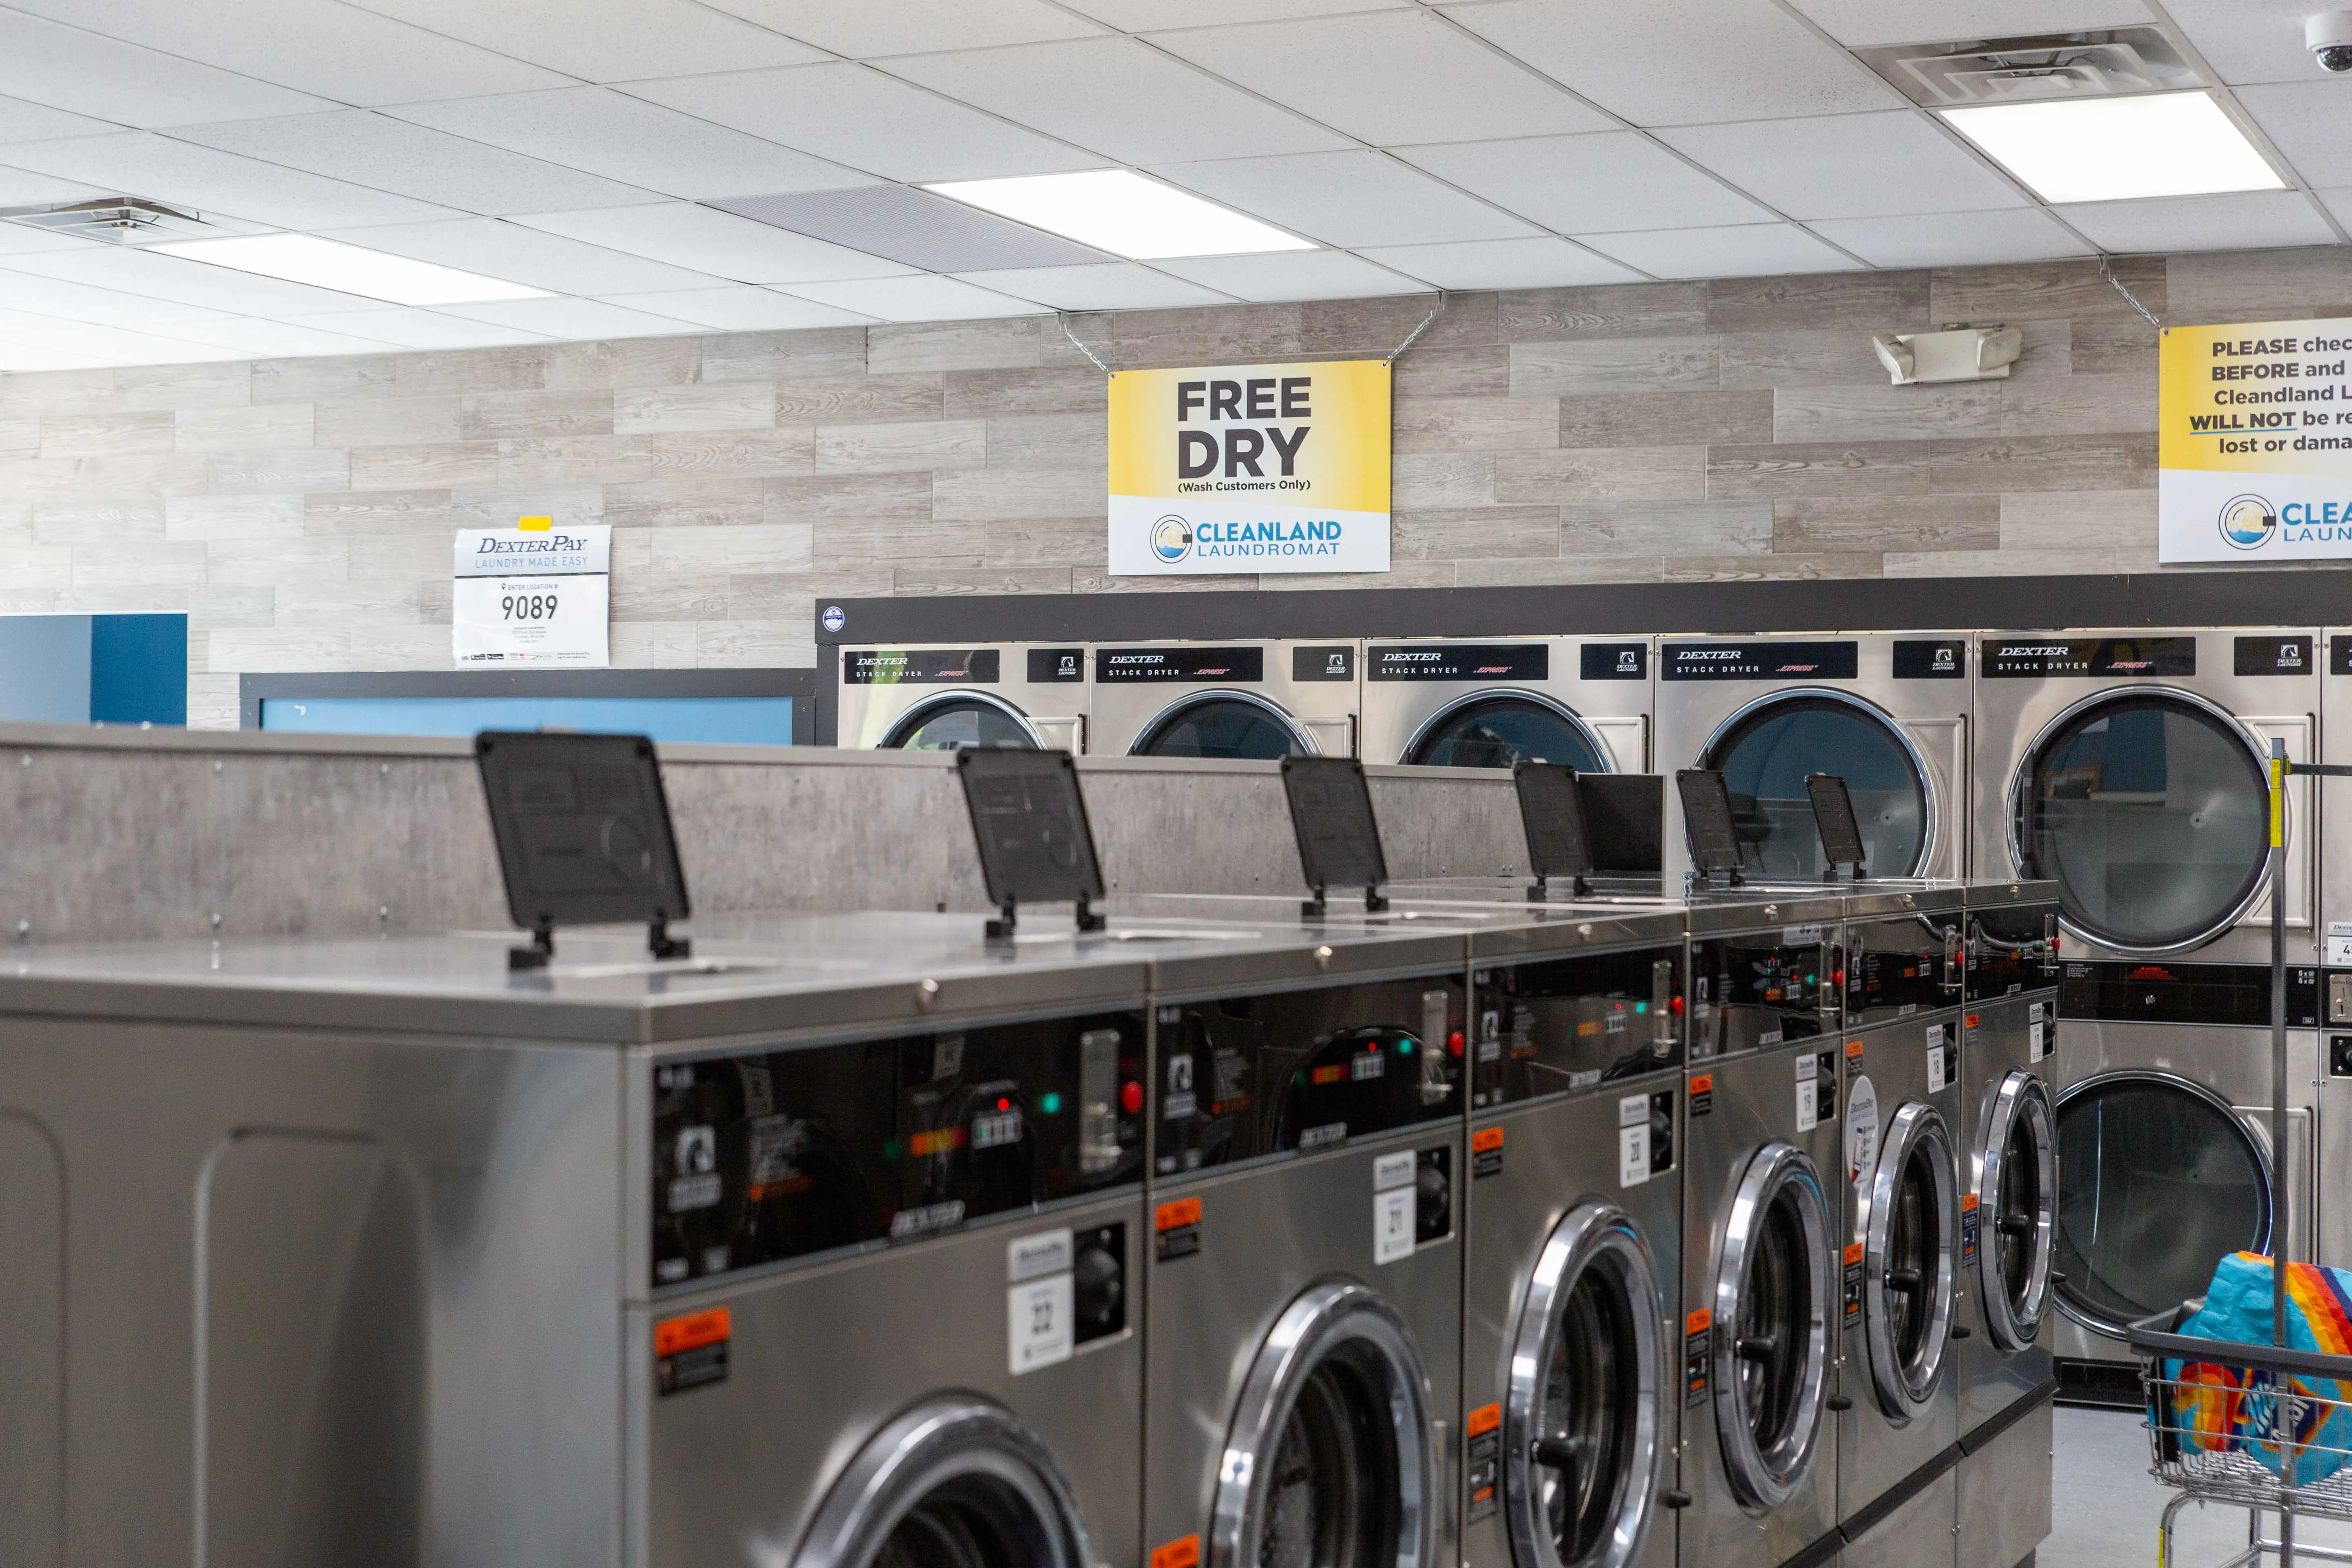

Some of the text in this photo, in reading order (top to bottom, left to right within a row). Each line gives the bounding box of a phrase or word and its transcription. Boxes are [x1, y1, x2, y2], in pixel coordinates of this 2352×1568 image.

[2212, 339, 2297, 357] PLEASE
[2212, 360, 2345, 381] BEFORE and
[1178, 377, 1311, 422] FREE
[2214, 385, 2334, 405] Cleandland
[2189, 414, 2244, 430] WILL
[2250, 412, 2296, 428] NOT
[2303, 410, 2329, 426] be
[1178, 426, 1311, 479] DRY
[2220, 435, 2352, 454] lost or dama
[1178, 479, 1310, 493] (Wash Customers Only)
[1196, 521, 1342, 543] CLEANLAND
[1198, 543, 1340, 557] LAUNDROMAT
[476, 556, 588, 568] LAUNDRY MADE EASY
[502, 595, 558, 620] 9089
[1382, 653, 1441, 661] DEXTER
[1677, 651, 1741, 659] DEXTER
[1998, 647, 2068, 655] DEXTER
